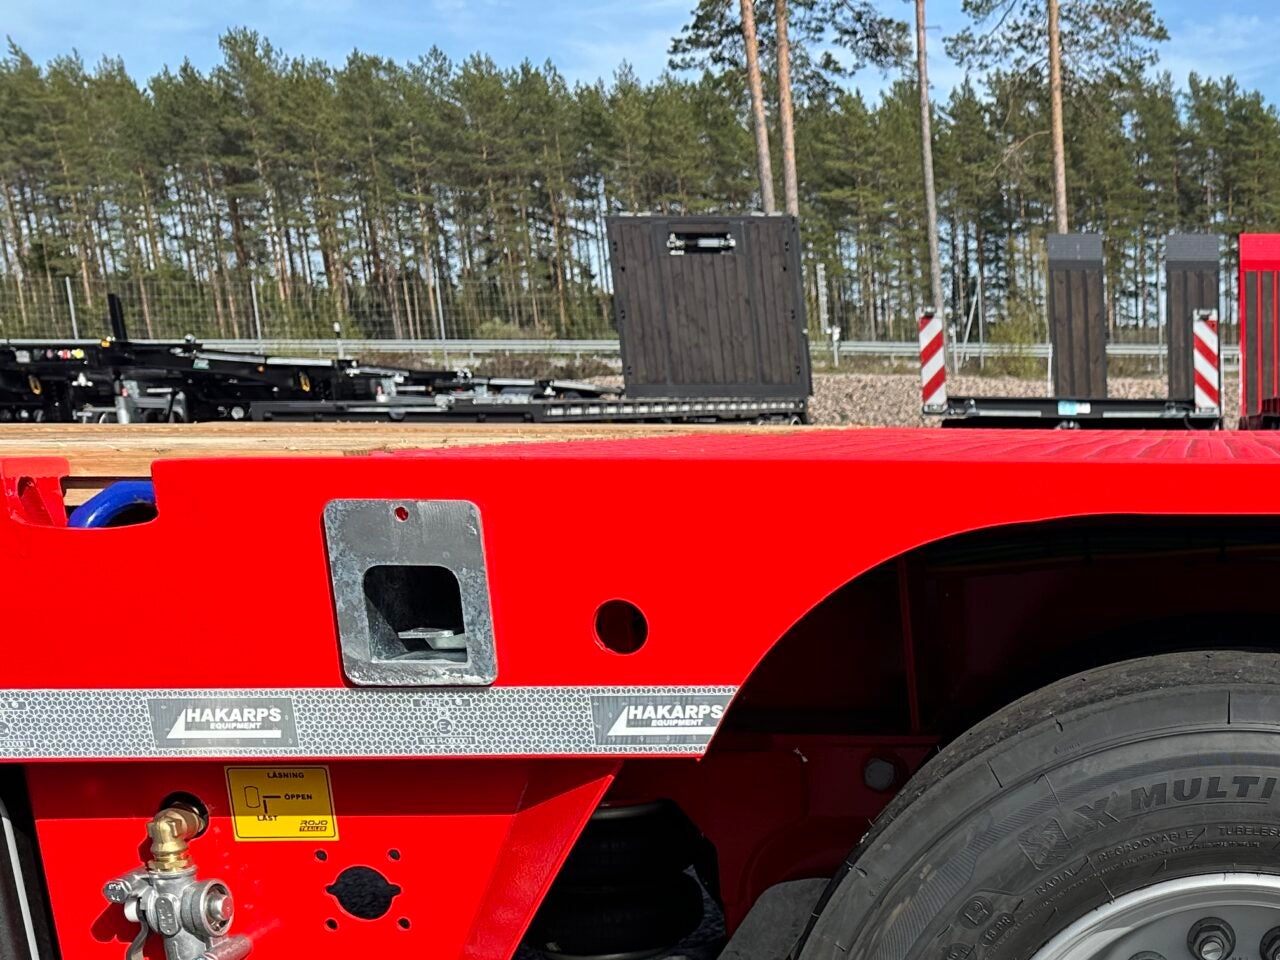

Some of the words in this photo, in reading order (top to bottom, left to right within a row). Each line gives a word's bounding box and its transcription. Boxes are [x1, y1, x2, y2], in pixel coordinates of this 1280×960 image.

[186, 708, 282, 722] HAKARPS
[629, 705, 724, 719] HAKARPS
[266, 771, 305, 779] LÅSNING
[284, 793, 313, 801] ÖPPEN
[1130, 776, 1277, 810] MULTI
